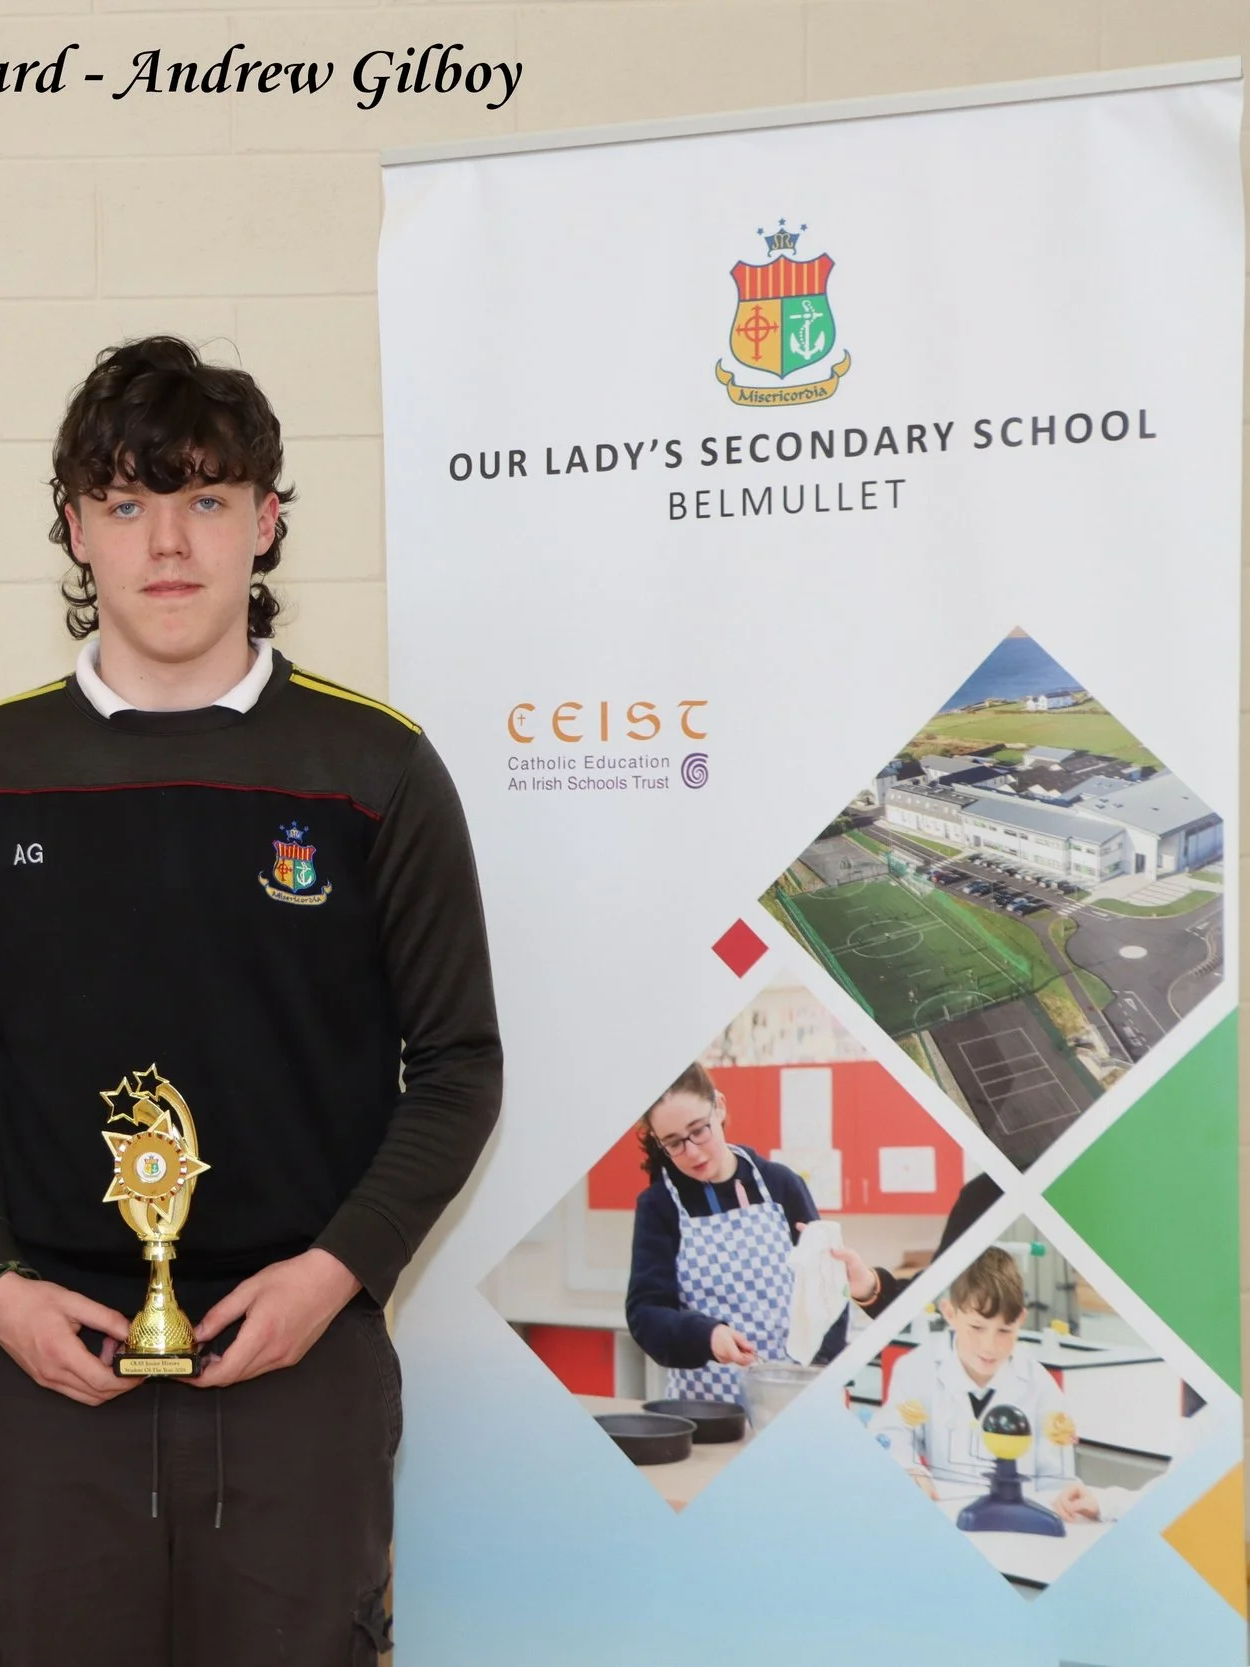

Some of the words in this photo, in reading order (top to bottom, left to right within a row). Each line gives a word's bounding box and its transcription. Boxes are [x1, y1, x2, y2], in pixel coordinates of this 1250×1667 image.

[738, 386, 828, 403] Misericordia
[449, 449, 528, 482] OUR
[700, 421, 955, 467] SECONDARY
[973, 408, 1157, 450] SCHOOL
[669, 478, 906, 521] BELMULLET
[507, 700, 709, 744] CEIST
[507, 756, 576, 771] Catholic
[584, 754, 670, 769] Education
[507, 777, 527, 791] An
[532, 776, 563, 791] Irish
[567, 775, 628, 791] Schools
[631, 774, 670, 790] Trust
[13, 842, 44, 866] AG
